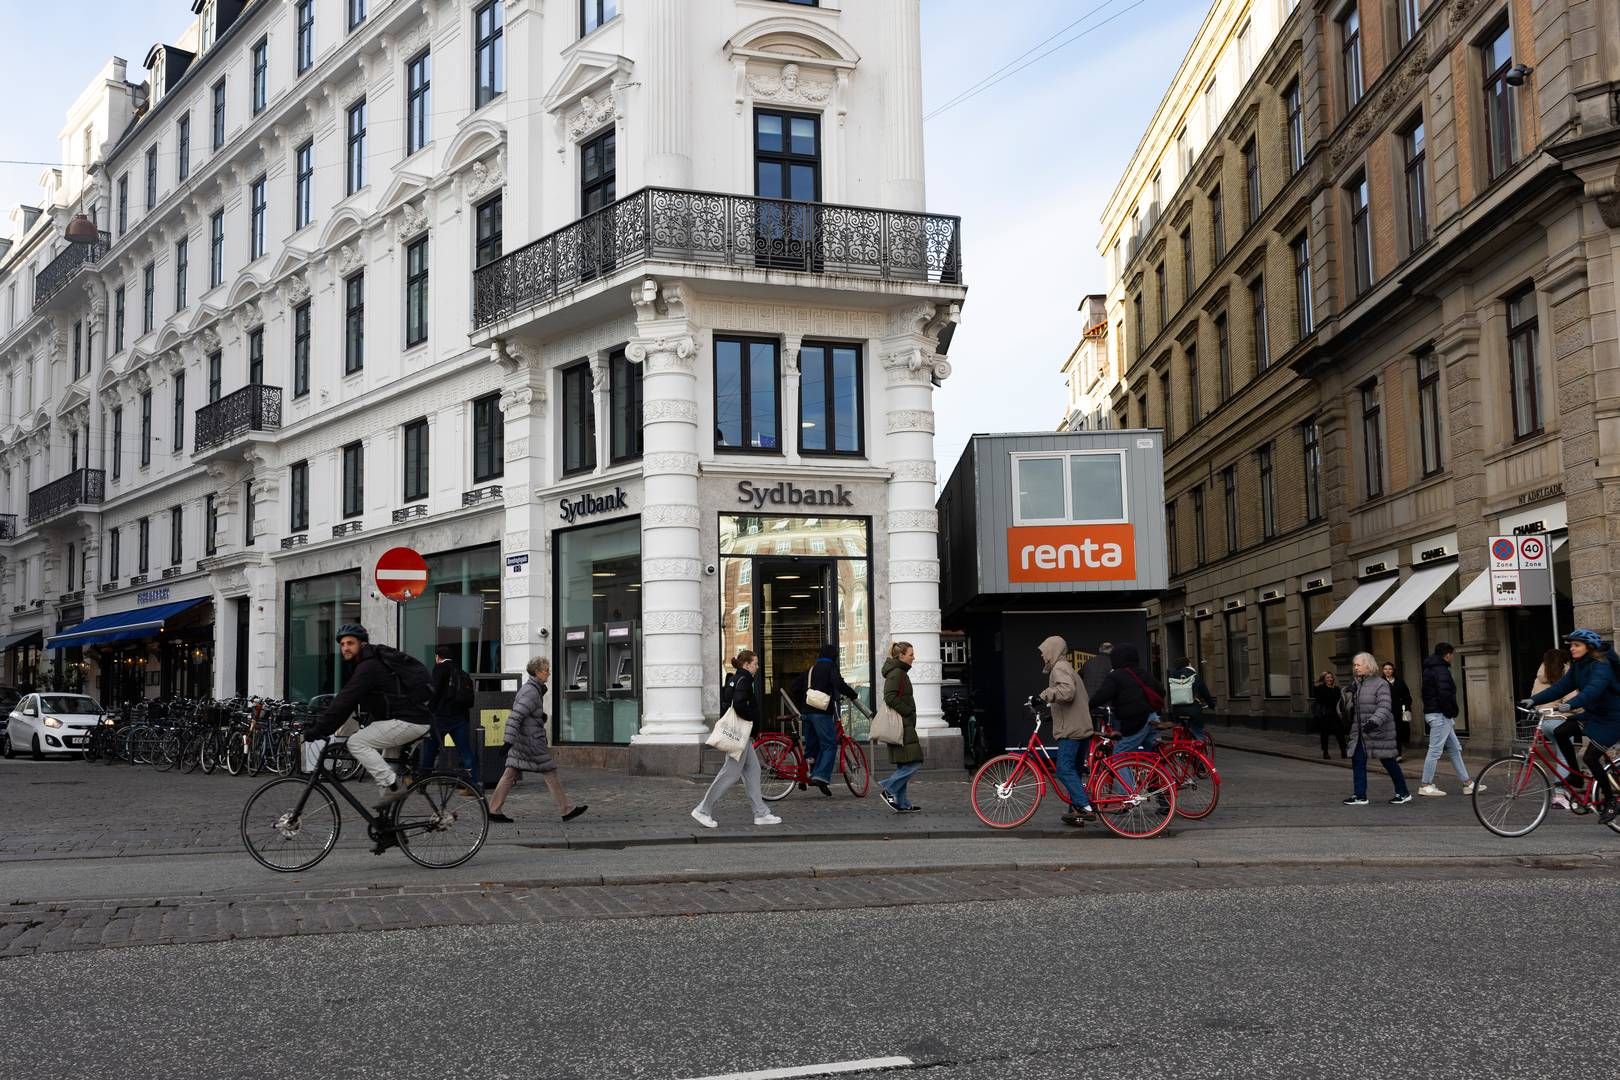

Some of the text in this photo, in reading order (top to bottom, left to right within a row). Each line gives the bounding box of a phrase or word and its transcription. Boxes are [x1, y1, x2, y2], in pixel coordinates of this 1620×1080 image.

[560, 487, 627, 523] Sydbank
[738, 481, 853, 509] Sydbank
[1513, 521, 1546, 536] CHANEL
[1021, 538, 1122, 570] renta
[1421, 547, 1446, 560] CHANEL
[1525, 544, 1539, 553] 40
